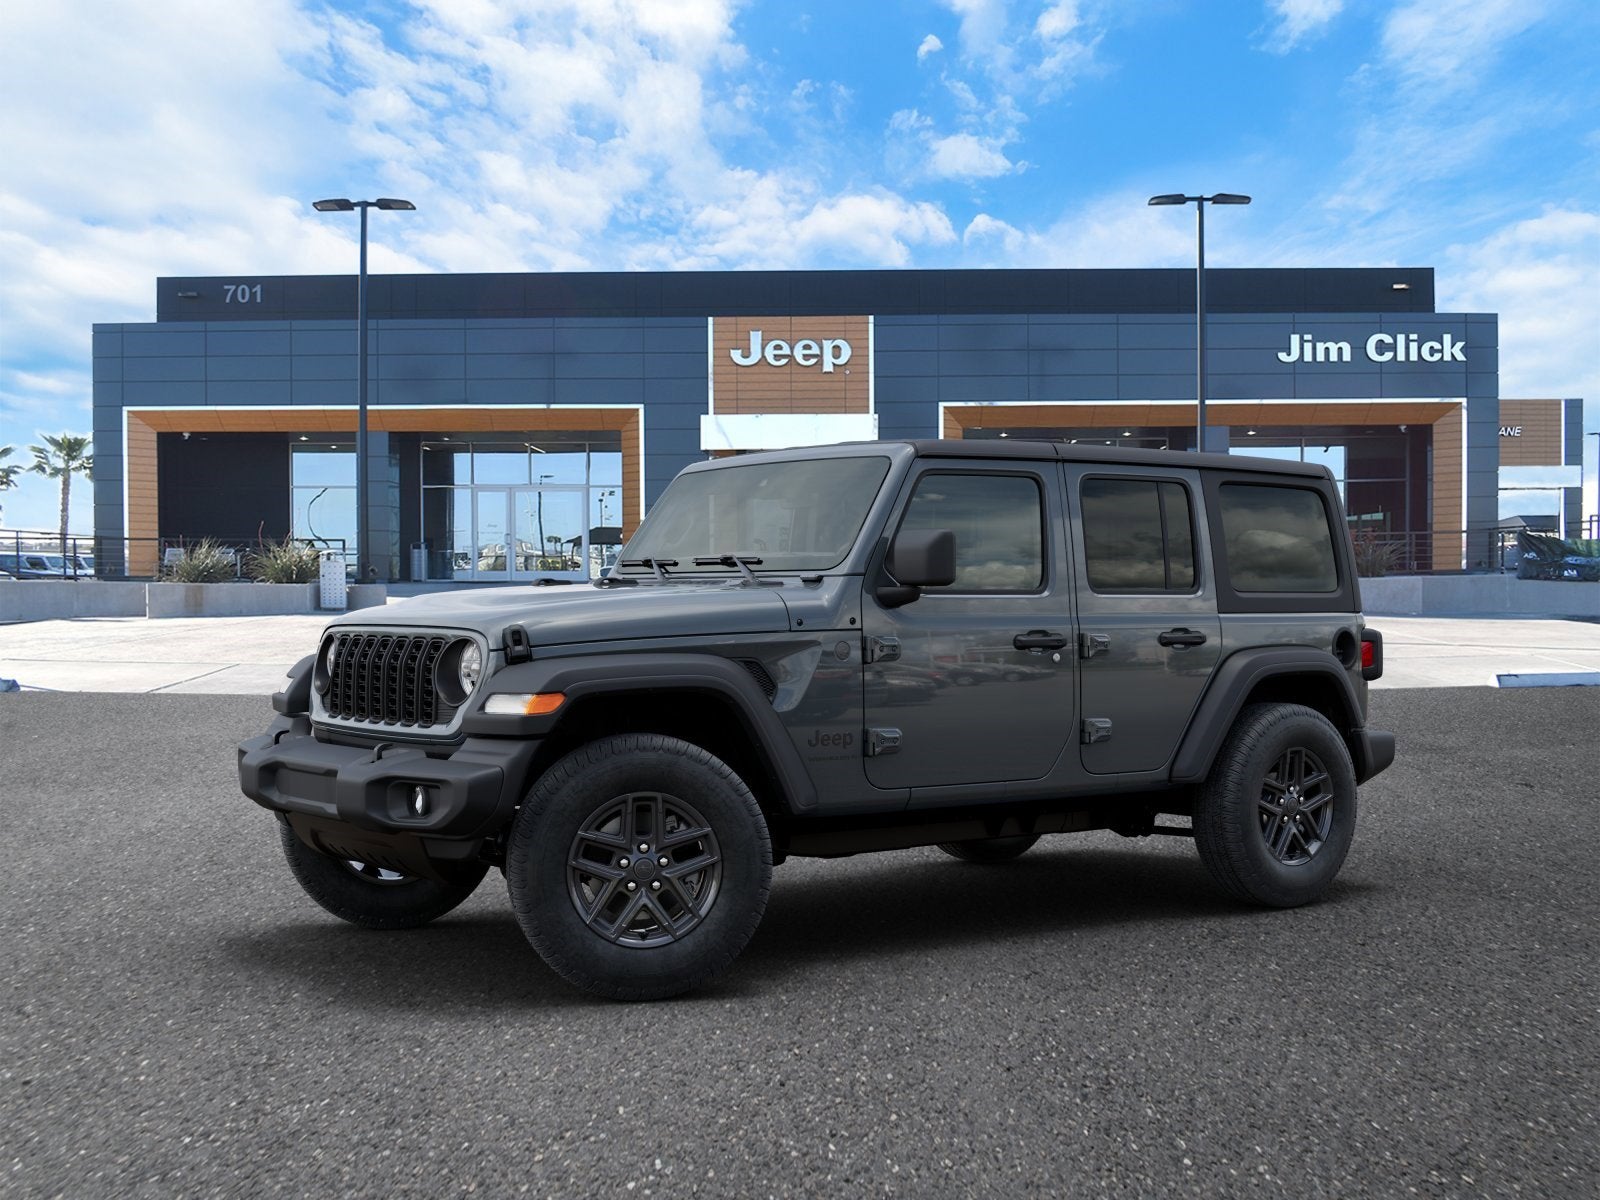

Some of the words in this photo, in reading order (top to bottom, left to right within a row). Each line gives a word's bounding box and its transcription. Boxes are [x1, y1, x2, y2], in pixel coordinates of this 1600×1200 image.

[223, 284, 262, 303] 701
[730, 330, 852, 373] Jeep
[1277, 333, 1352, 363] Jim
[1365, 333, 1467, 362] Click
[807, 729, 854, 749] Jeep
